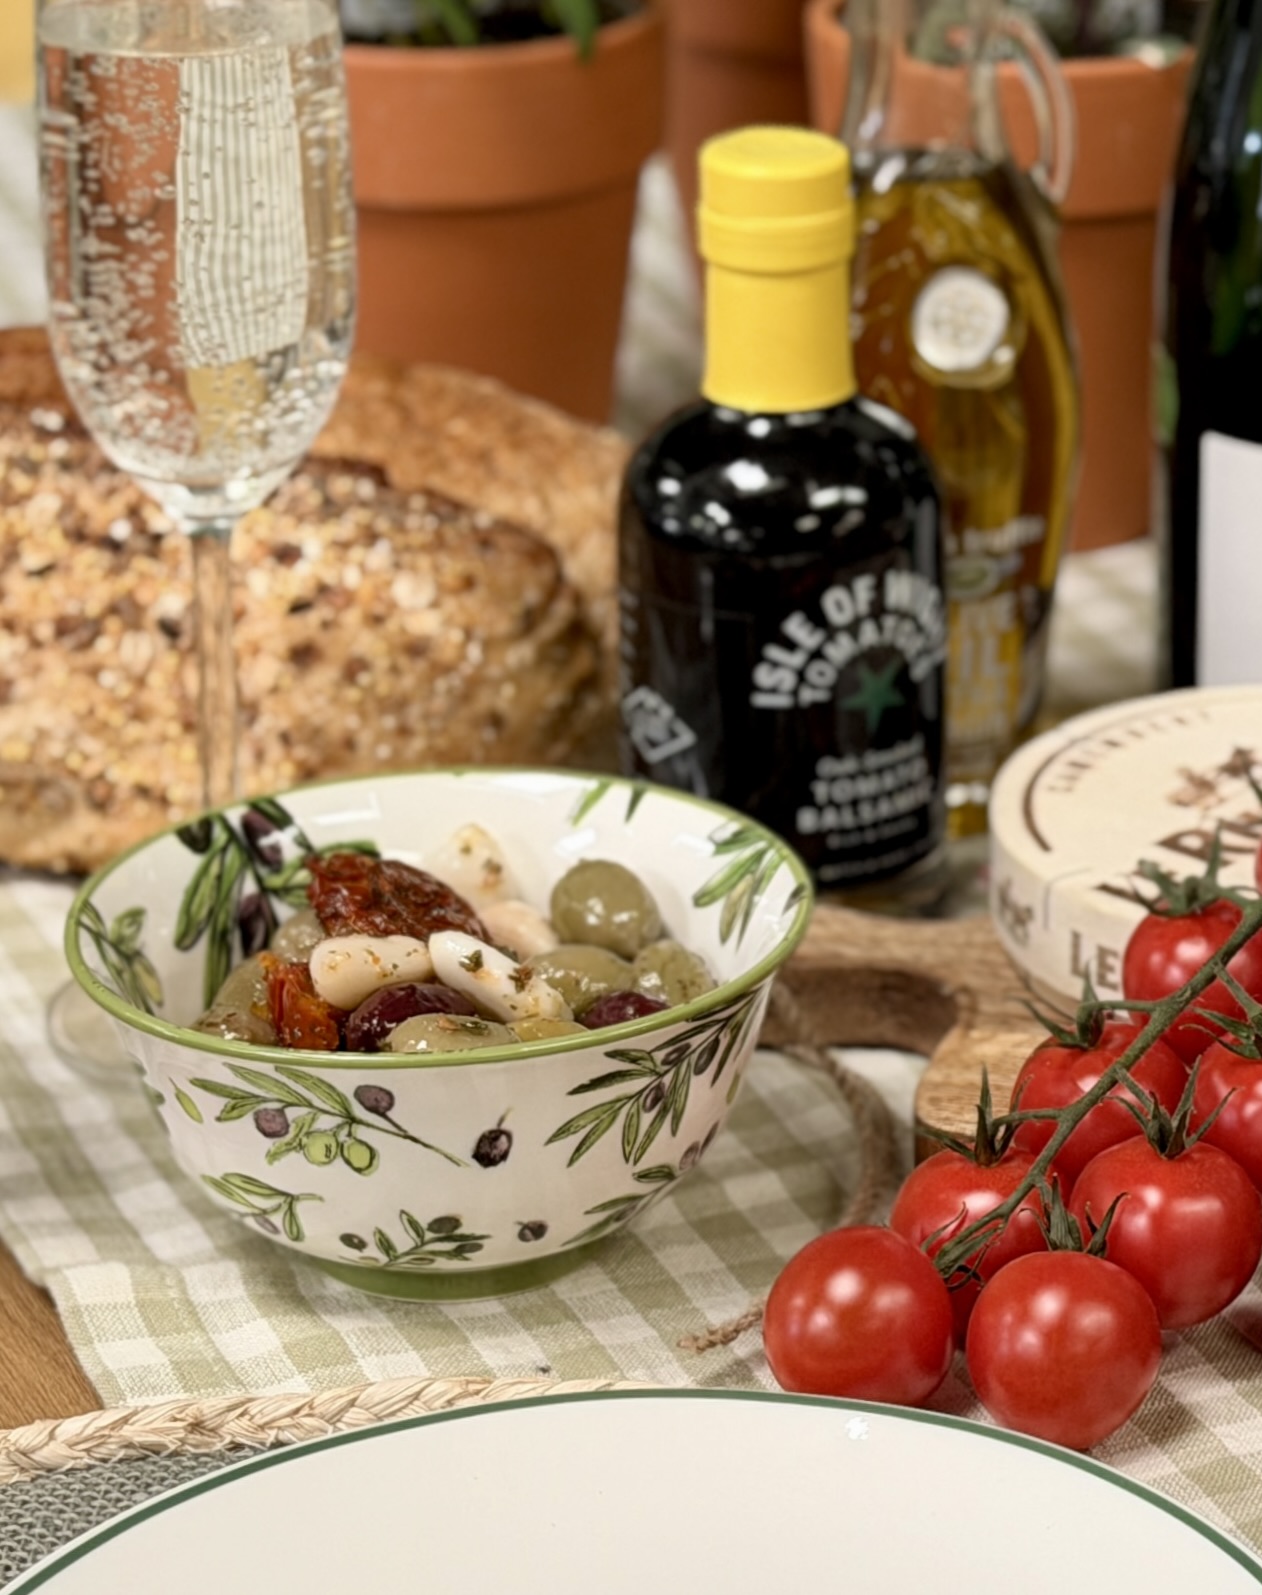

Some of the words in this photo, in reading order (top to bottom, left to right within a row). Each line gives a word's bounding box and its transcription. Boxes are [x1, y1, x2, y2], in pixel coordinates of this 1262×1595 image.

[750, 609, 828, 710] ISLE
[820, 572, 877, 629] OF
[1071, 929, 1120, 991] LE
